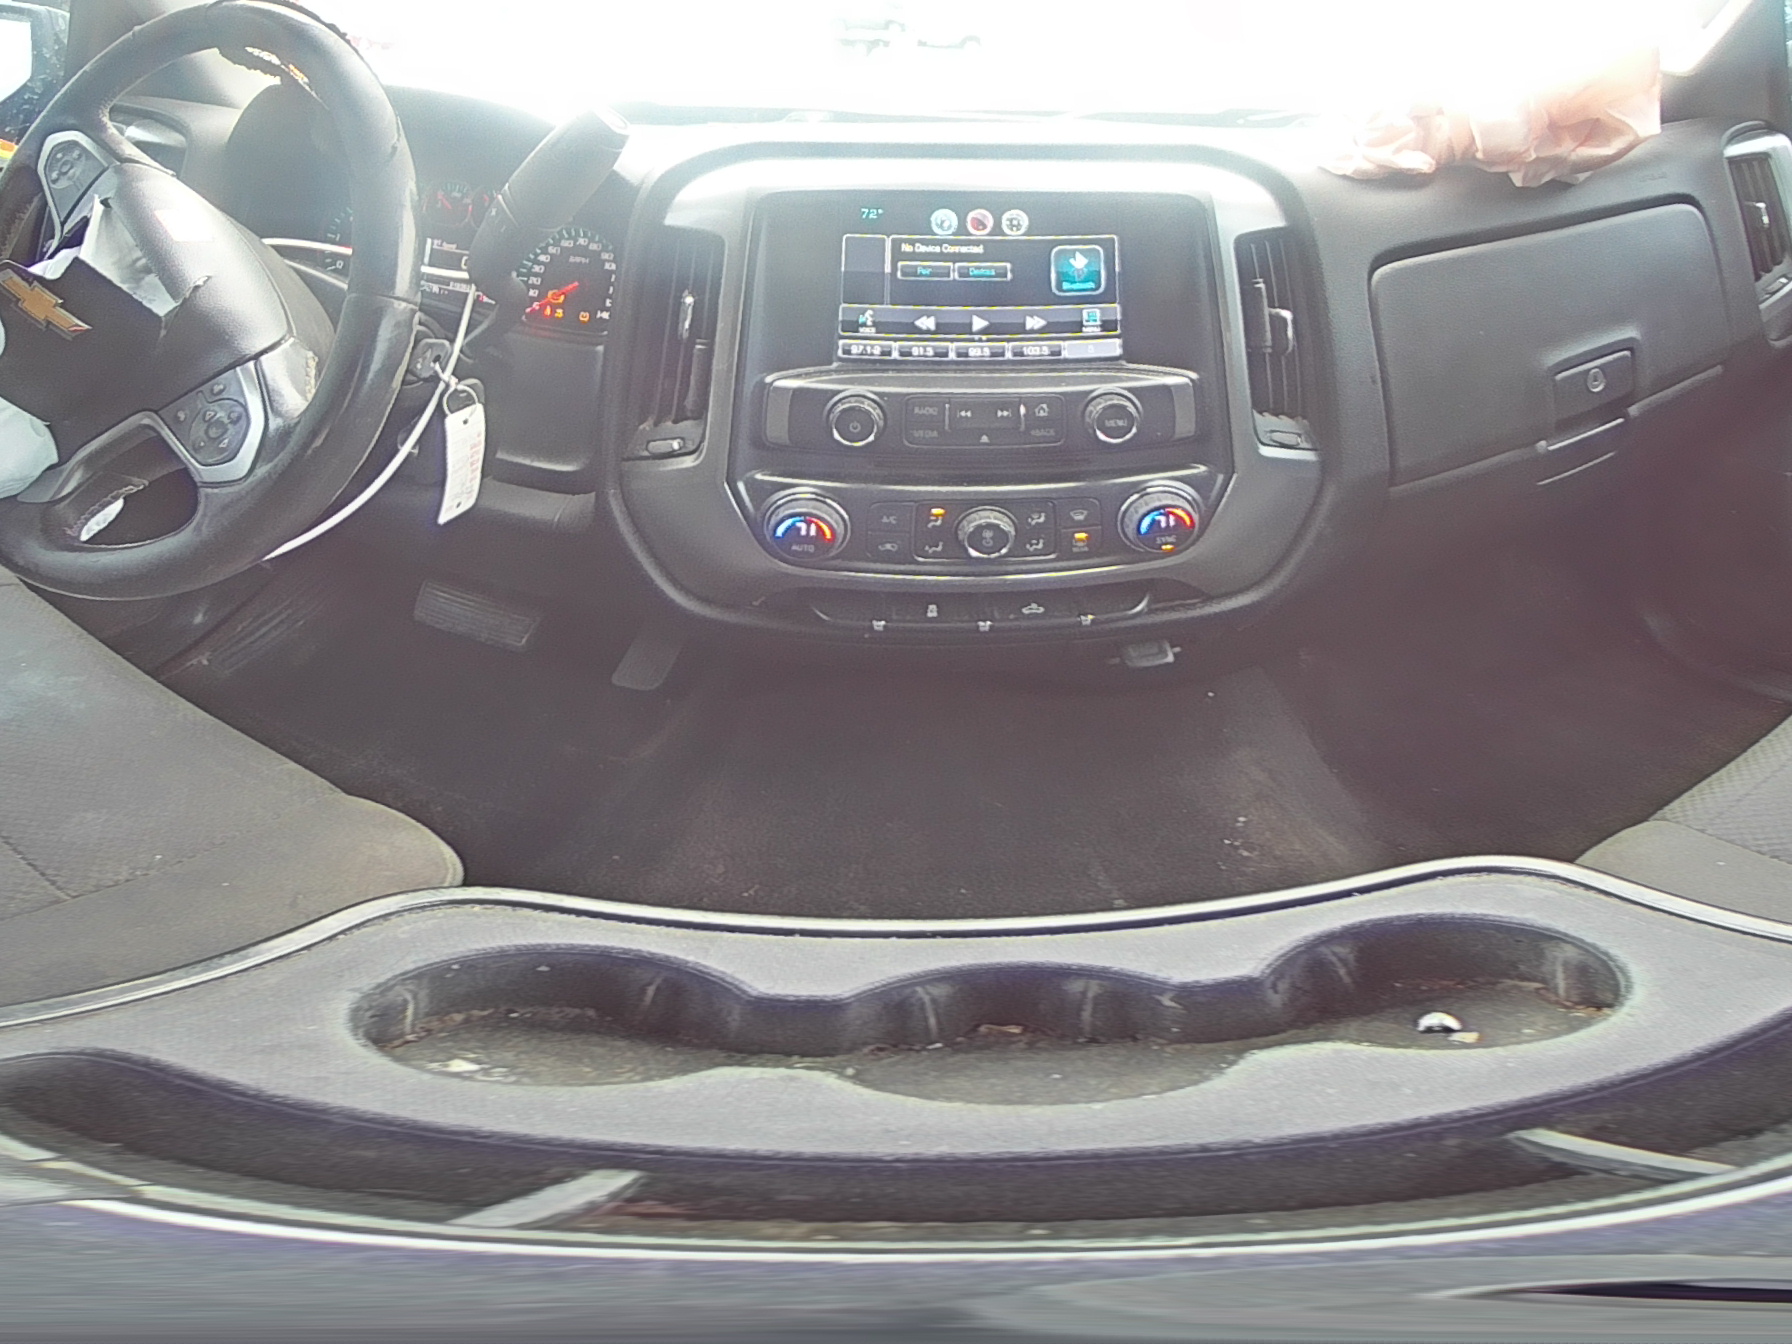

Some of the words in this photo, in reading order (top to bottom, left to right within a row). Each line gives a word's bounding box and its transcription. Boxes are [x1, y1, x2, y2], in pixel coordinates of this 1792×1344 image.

[901, 243, 914, 253] No
[914, 243, 941, 253] Device
[941, 244, 984, 254] Connected
[1104, 417, 1128, 428] MENU
[790, 544, 815, 553] AUTO
